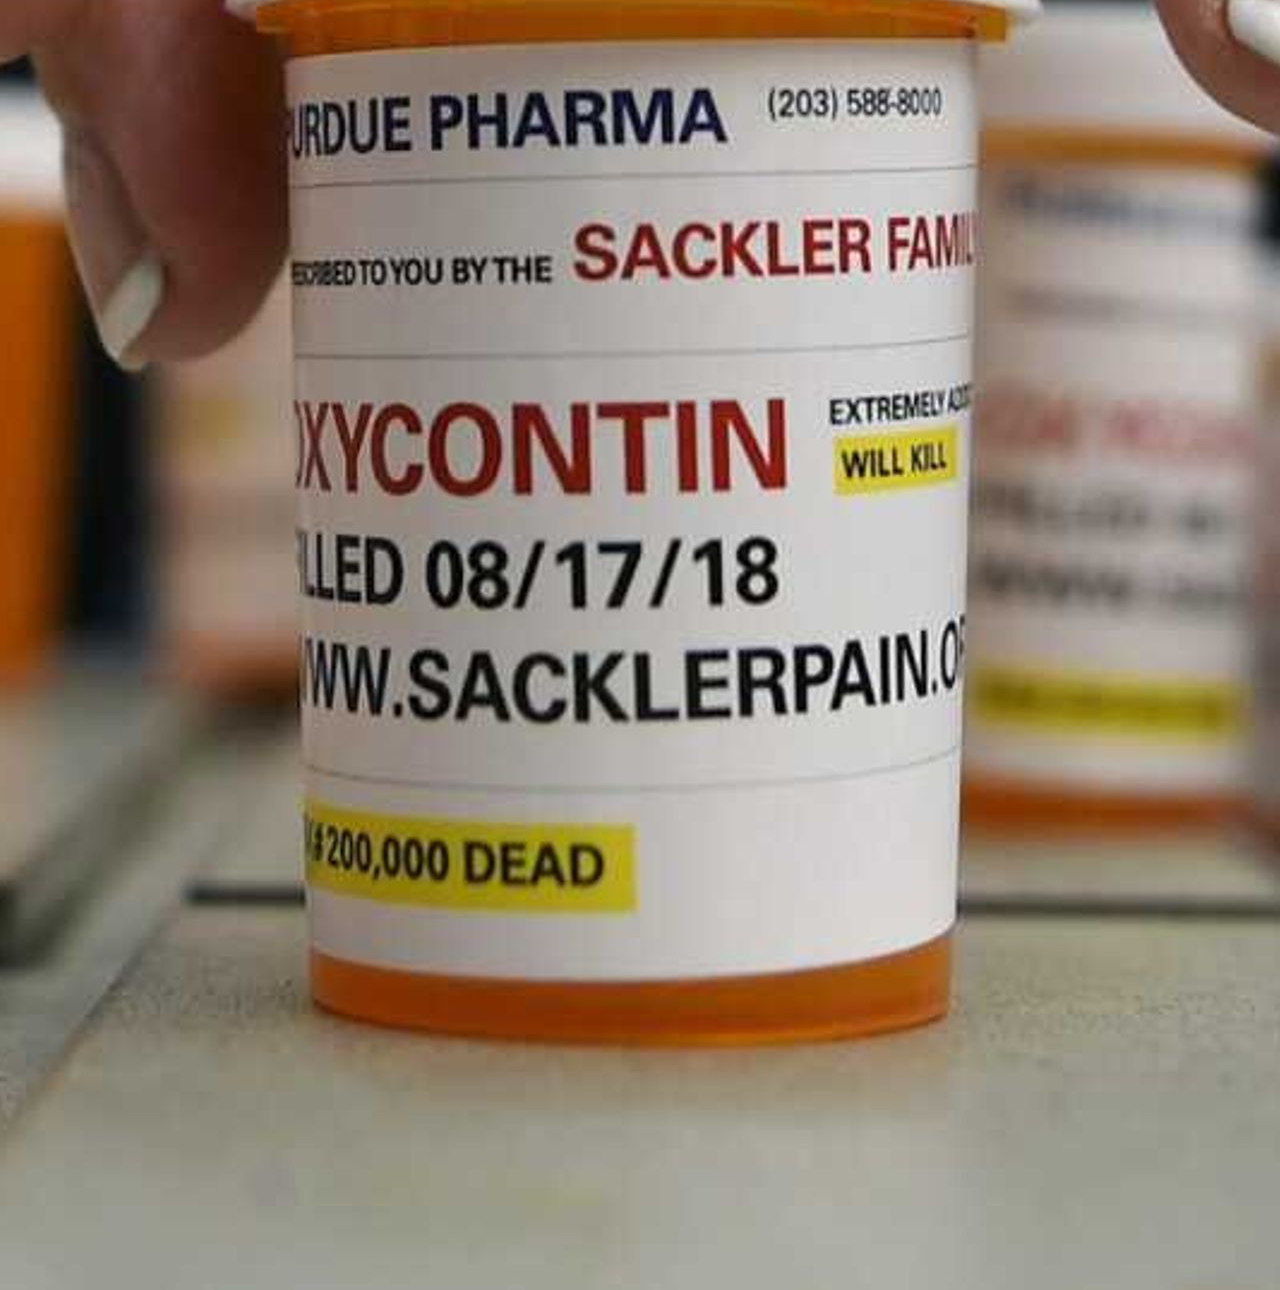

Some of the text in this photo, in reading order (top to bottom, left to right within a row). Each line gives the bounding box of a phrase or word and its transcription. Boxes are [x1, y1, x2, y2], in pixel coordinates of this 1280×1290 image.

[292, 86, 942, 158] URDUE PHARMA (203) 588-8000
[357, 259, 387, 286] TO
[388, 257, 444, 286] YOU
[451, 257, 488, 286] BY
[490, 255, 554, 285] THE
[573, 217, 872, 282] SACKLER
[887, 211, 982, 273] FAMIL
[829, 390, 947, 426] EXTREMELY
[840, 440, 948, 480] WILL KILL
[296, 532, 781, 610] LLED 08/17/18
[303, 614, 965, 724] WW.SACKLERPAIN.O
[327, 824, 451, 883] 200,000
[463, 841, 607, 889] DEAD
